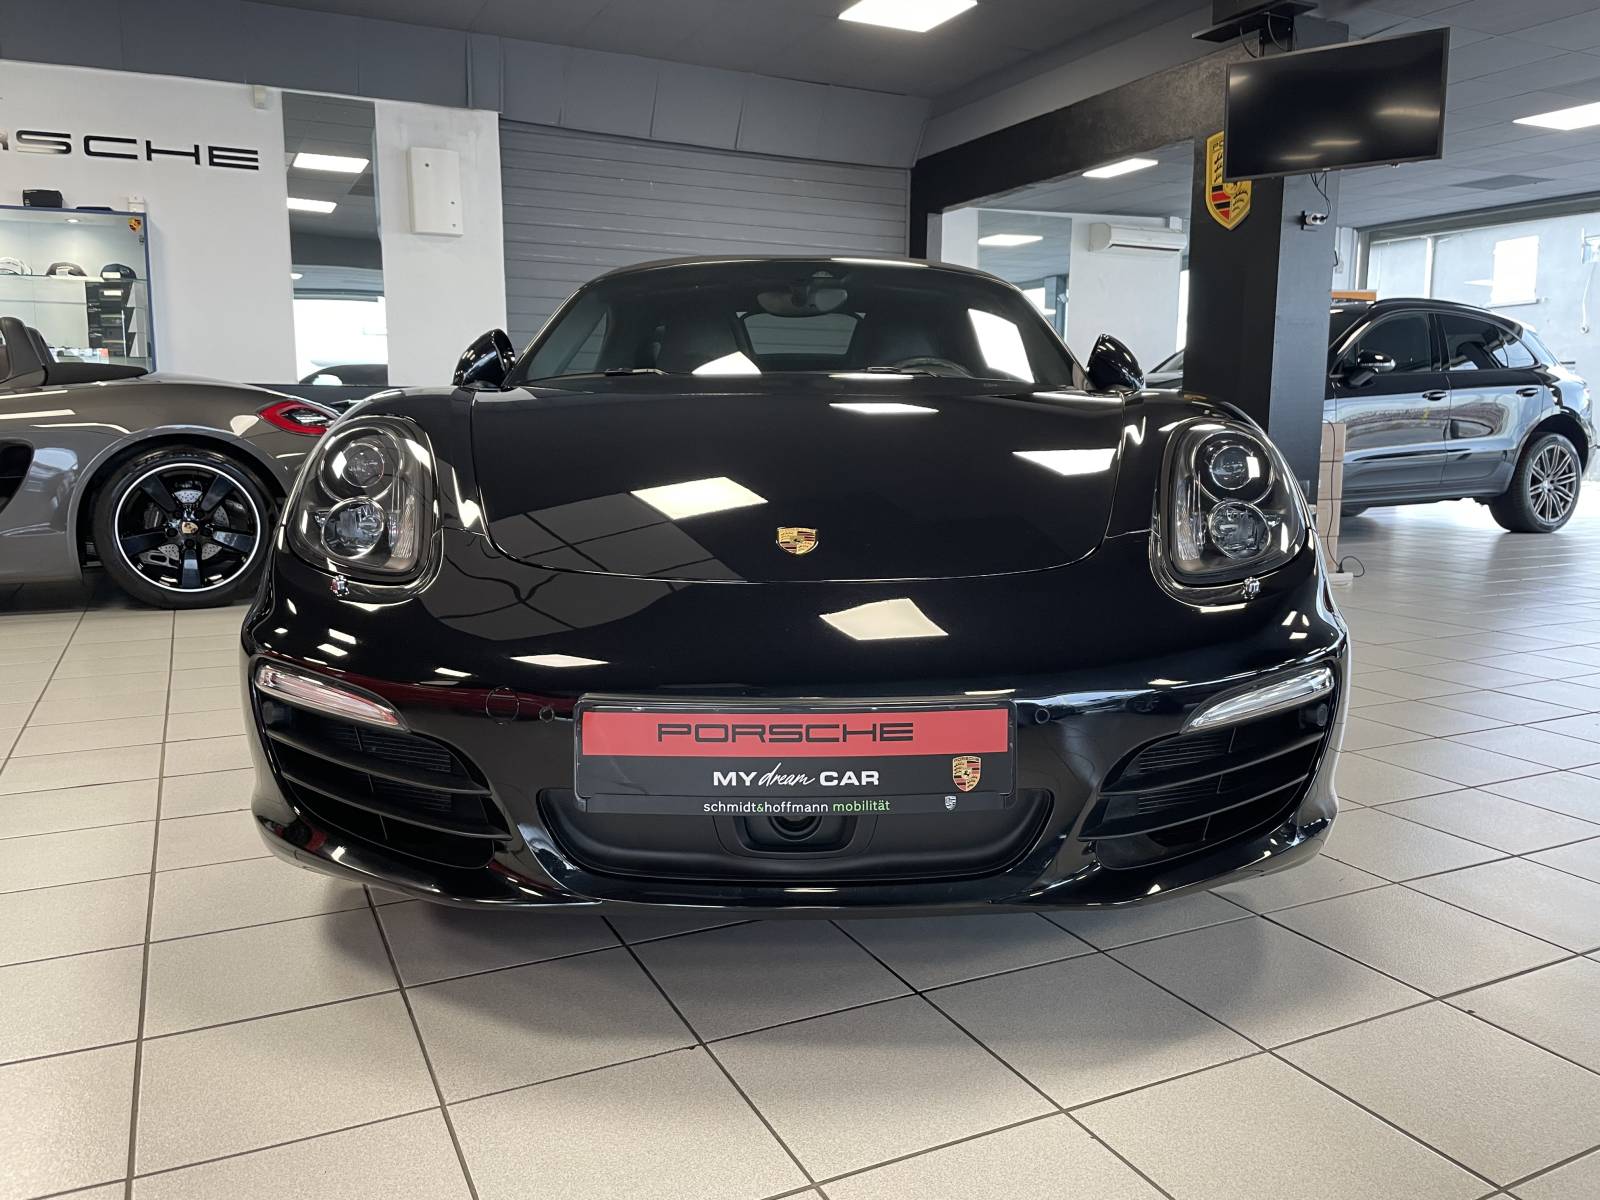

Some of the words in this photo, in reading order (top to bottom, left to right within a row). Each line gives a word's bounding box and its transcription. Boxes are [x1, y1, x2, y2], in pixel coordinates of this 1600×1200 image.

[0, 129, 259, 171] SCHE
[657, 722, 914, 743] PORSCHE
[713, 771, 757, 786] MY
[758, 762, 815, 787] dream
[819, 770, 880, 786] CAR
[832, 800, 890, 812] mobilität
